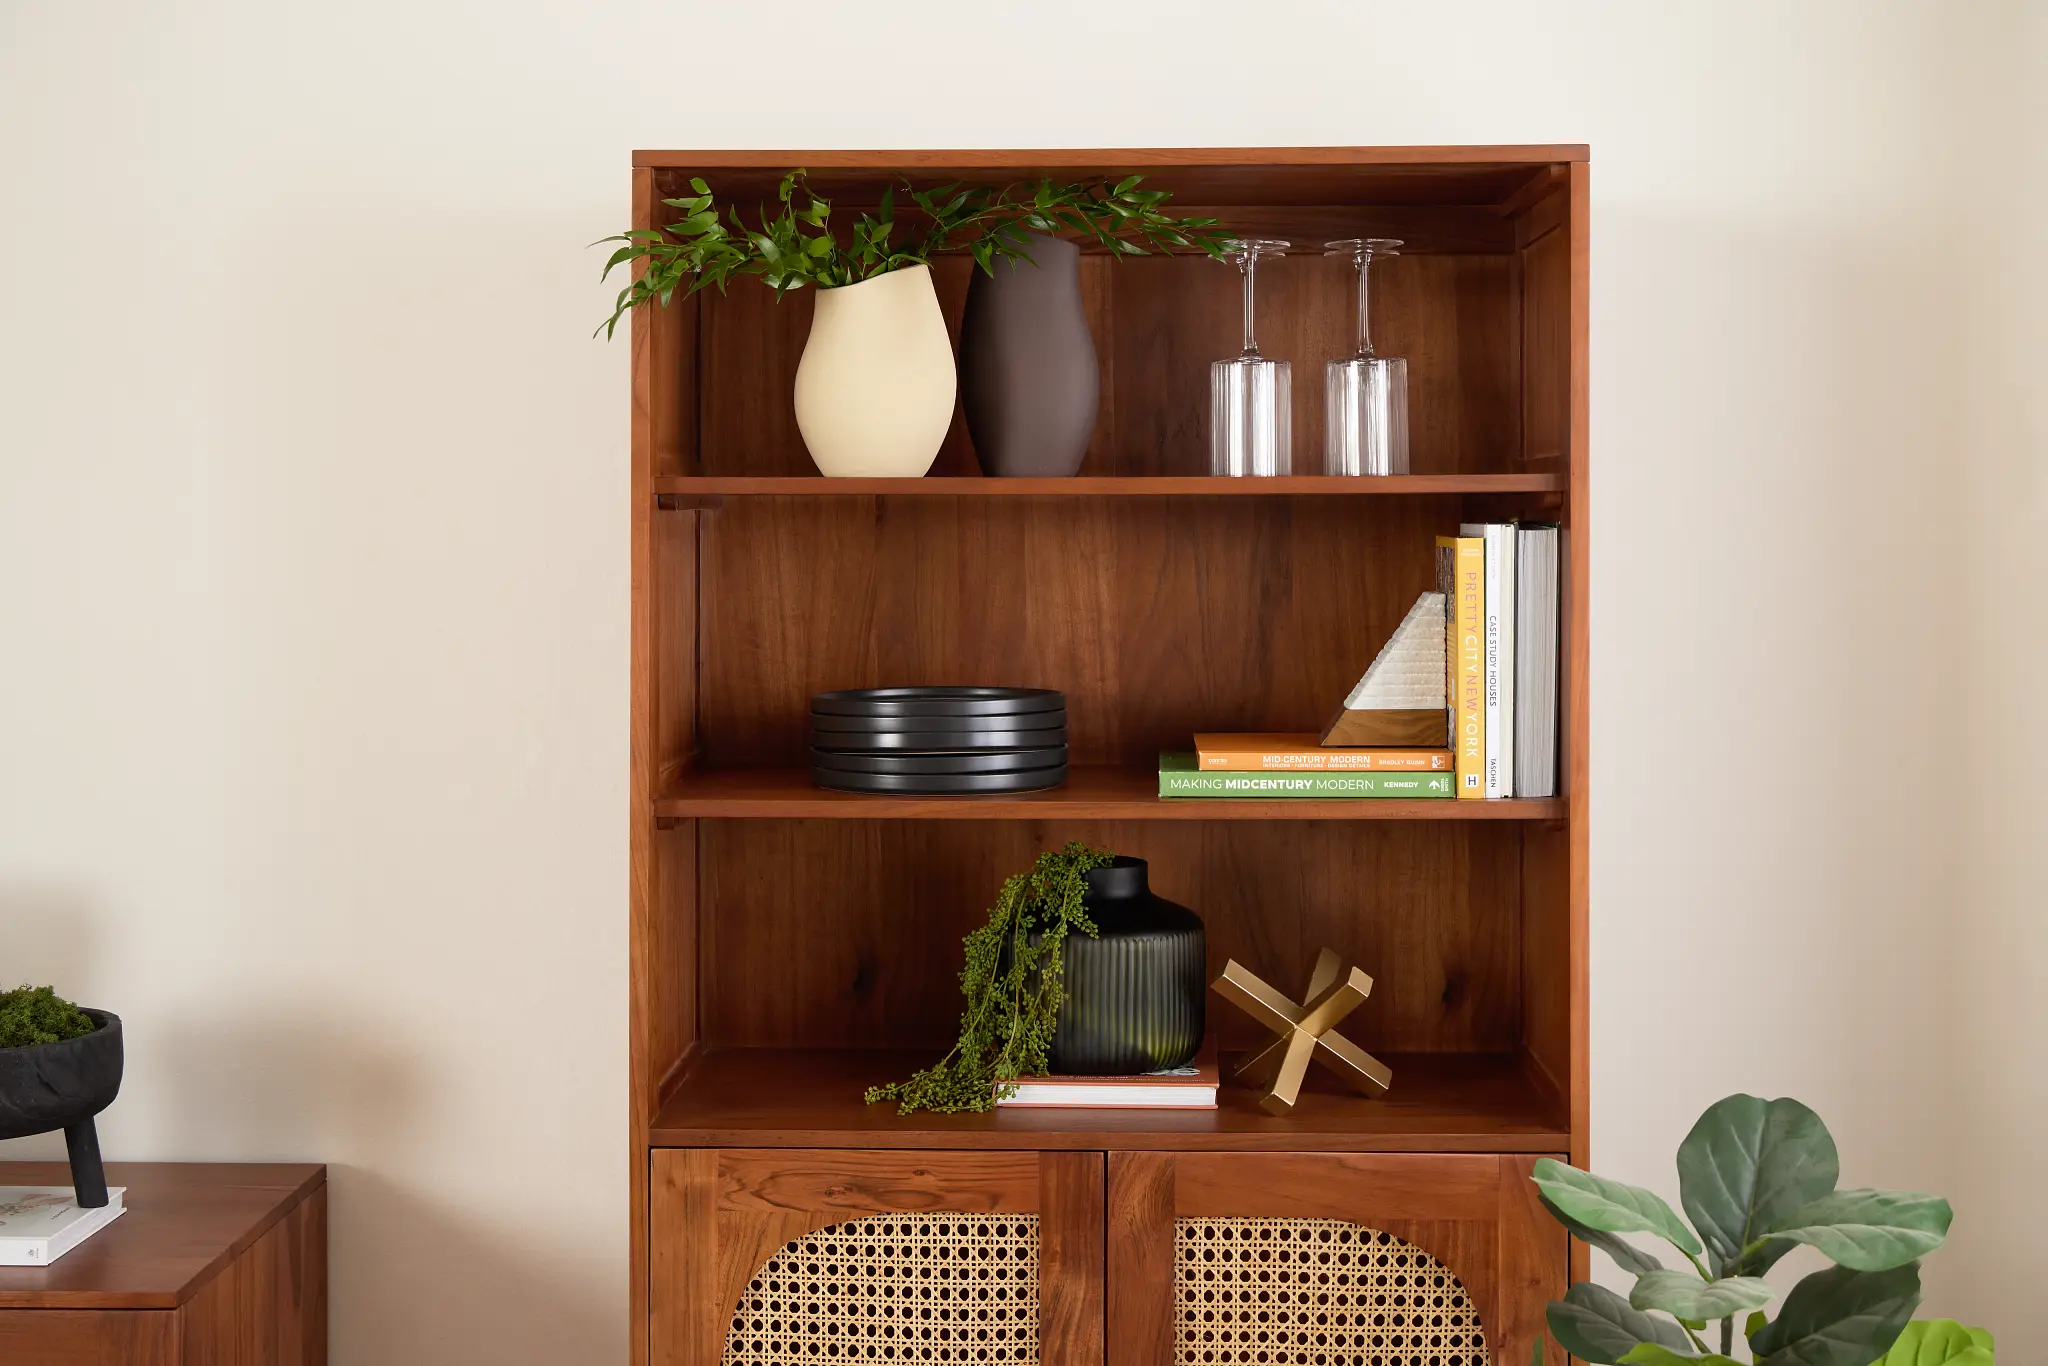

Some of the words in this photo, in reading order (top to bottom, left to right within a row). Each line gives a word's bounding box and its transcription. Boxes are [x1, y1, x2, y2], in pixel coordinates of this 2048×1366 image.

[1489, 615, 1497, 637] CASE
[1489, 639, 1497, 668] STUDY
[1489, 670, 1497, 707] HOUSES
[1263, 755, 1327, 764] MID-CENTURY
[1329, 755, 1371, 764] MODERN
[1170, 779, 1222, 789] MAKING
[1225, 779, 1313, 790] MIDCENTURY
[1316, 779, 1374, 790] MODERN
